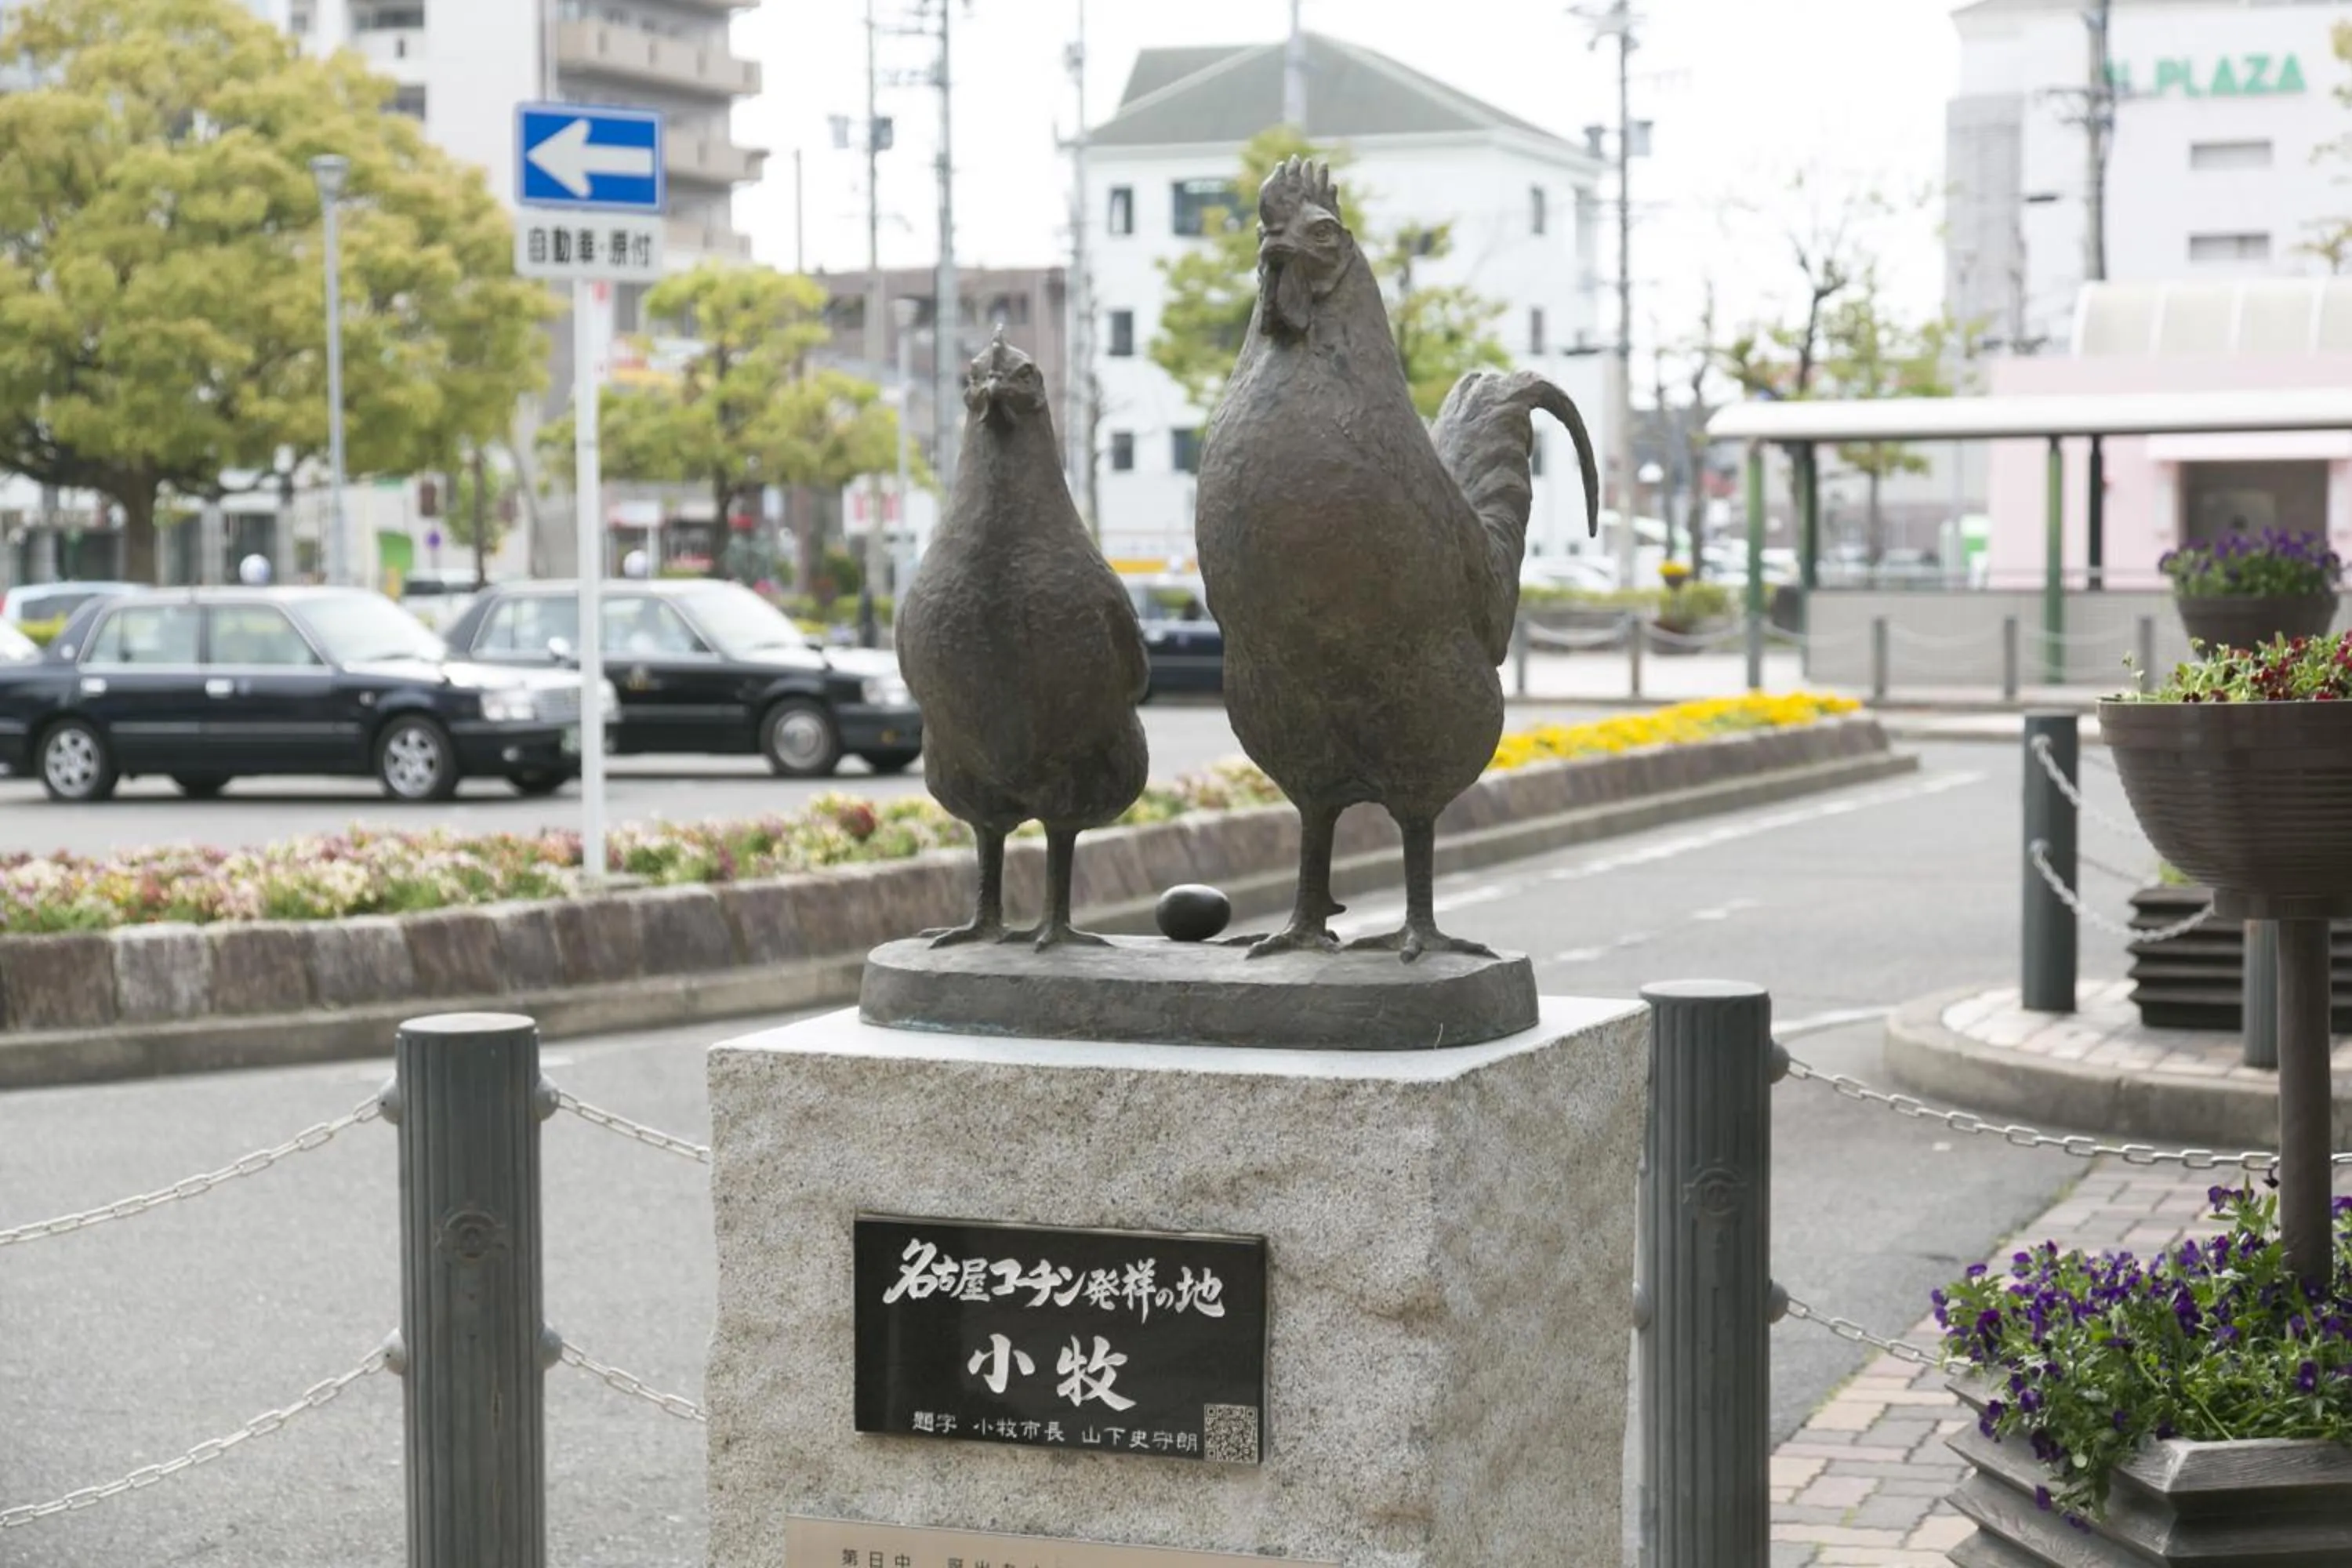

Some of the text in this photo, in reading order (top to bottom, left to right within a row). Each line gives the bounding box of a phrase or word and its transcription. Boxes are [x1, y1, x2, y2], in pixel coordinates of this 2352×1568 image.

[2155, 51, 2307, 96] PLAZA
[527, 226, 652, 268] 自動車・原付
[882, 1238, 1225, 1323] 名古屋コーチン発祥の地
[967, 1334, 1137, 1411] 小牧
[972, 1417, 1065, 1443] 小牧市長
[1080, 1425, 1198, 1452] 山下史守朗
